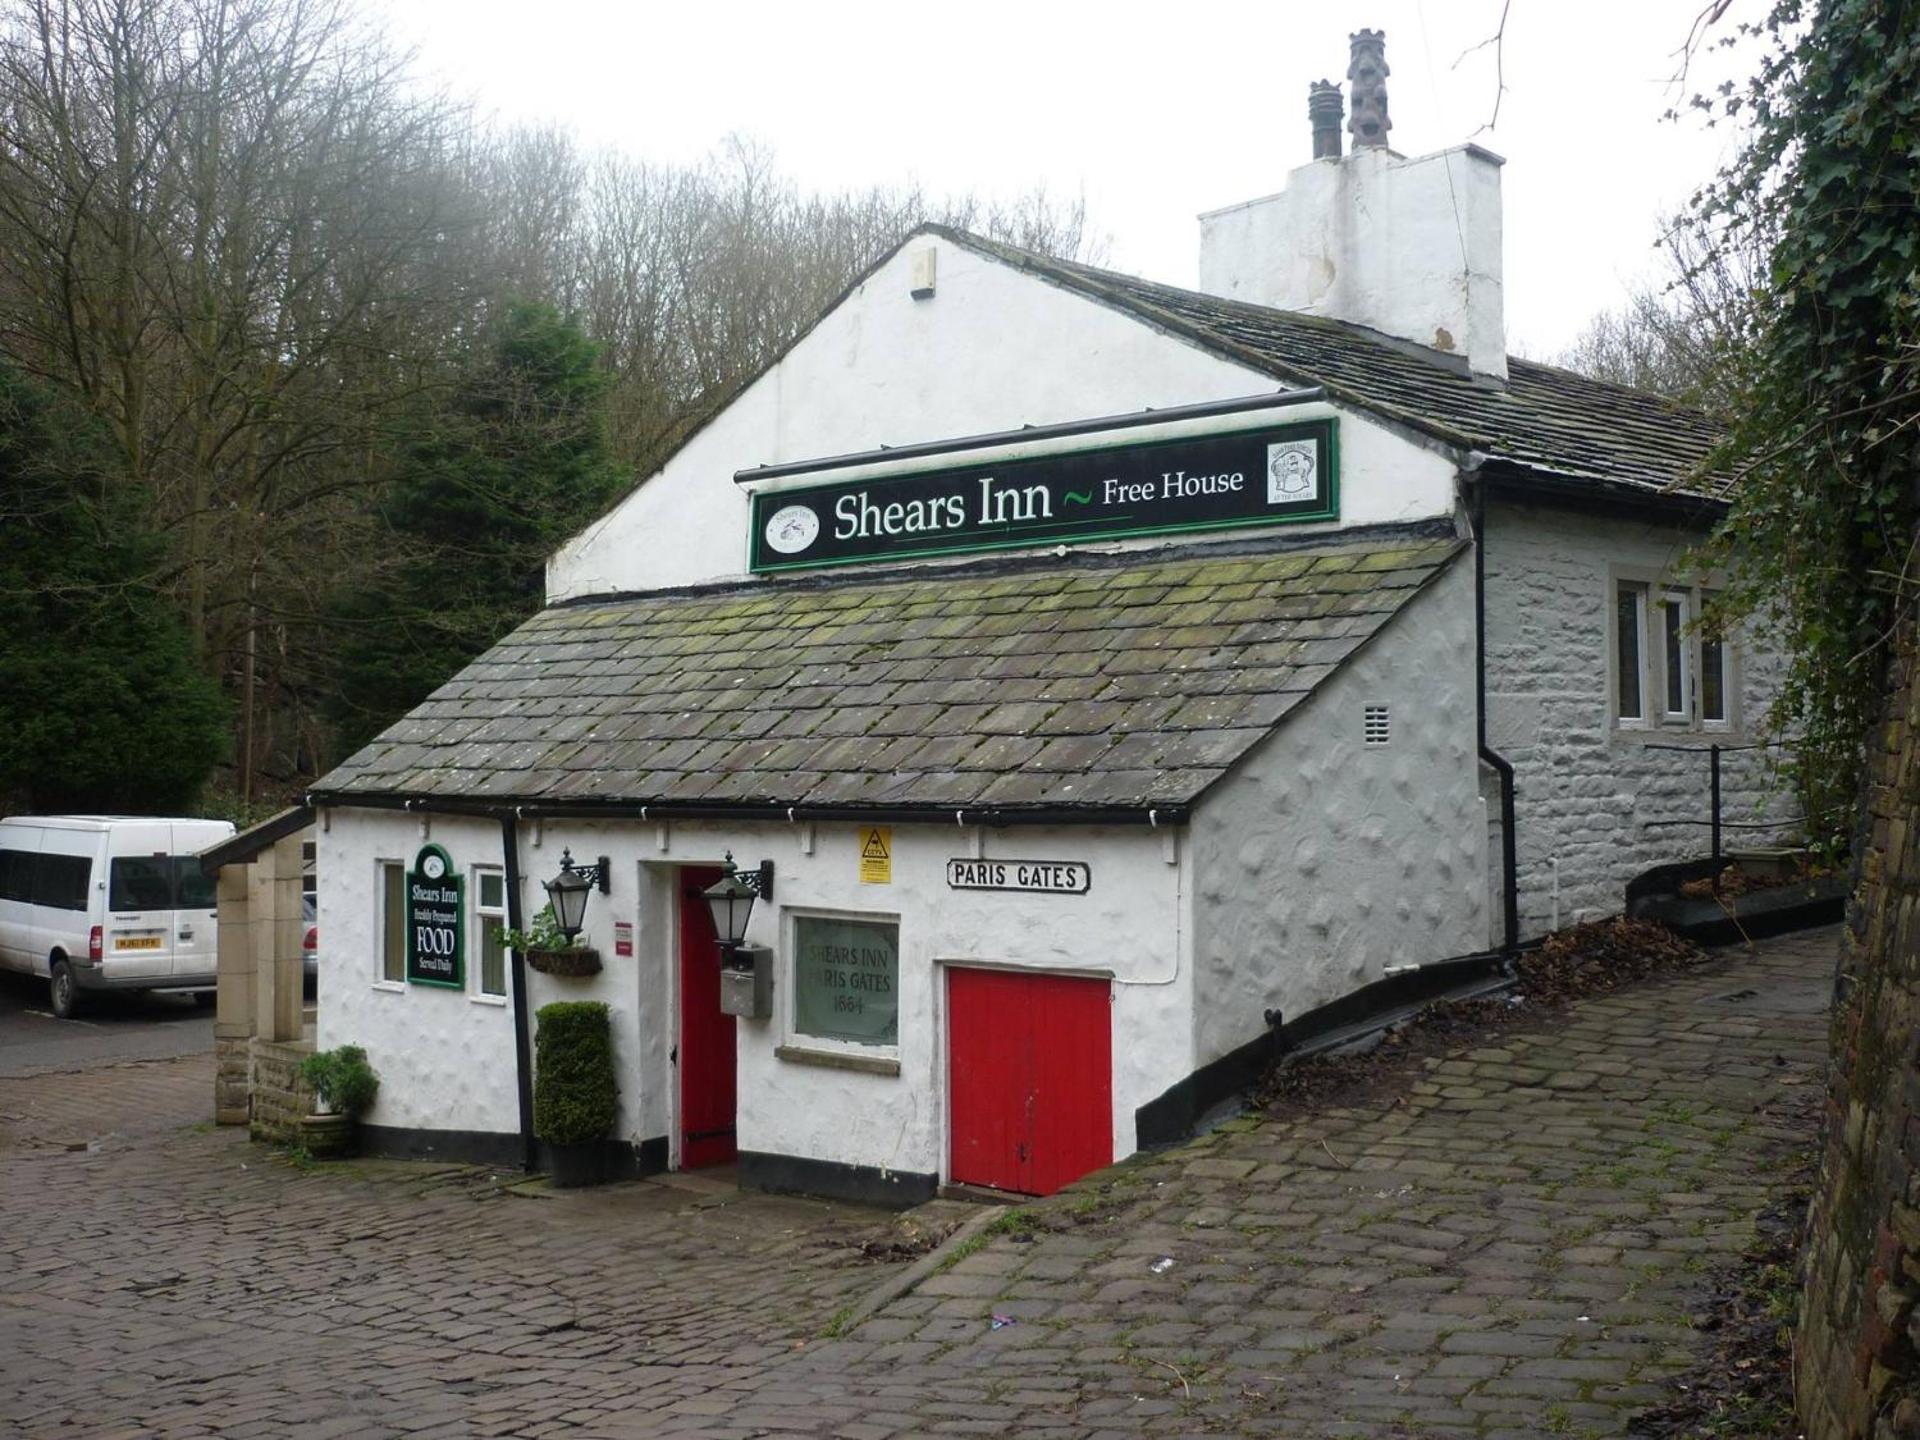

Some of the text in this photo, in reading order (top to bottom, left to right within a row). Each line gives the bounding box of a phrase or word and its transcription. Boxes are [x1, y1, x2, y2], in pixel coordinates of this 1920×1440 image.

[1102, 470, 1244, 505] Free House
[834, 477, 1053, 540] Shears Inn
[954, 863, 1077, 888] PARIS GATES
[412, 884, 458, 904] Shears Inn
[416, 926, 455, 955] FOOD
[808, 945, 888, 969] SHEARS INN
[850, 972, 891, 993] GATES
